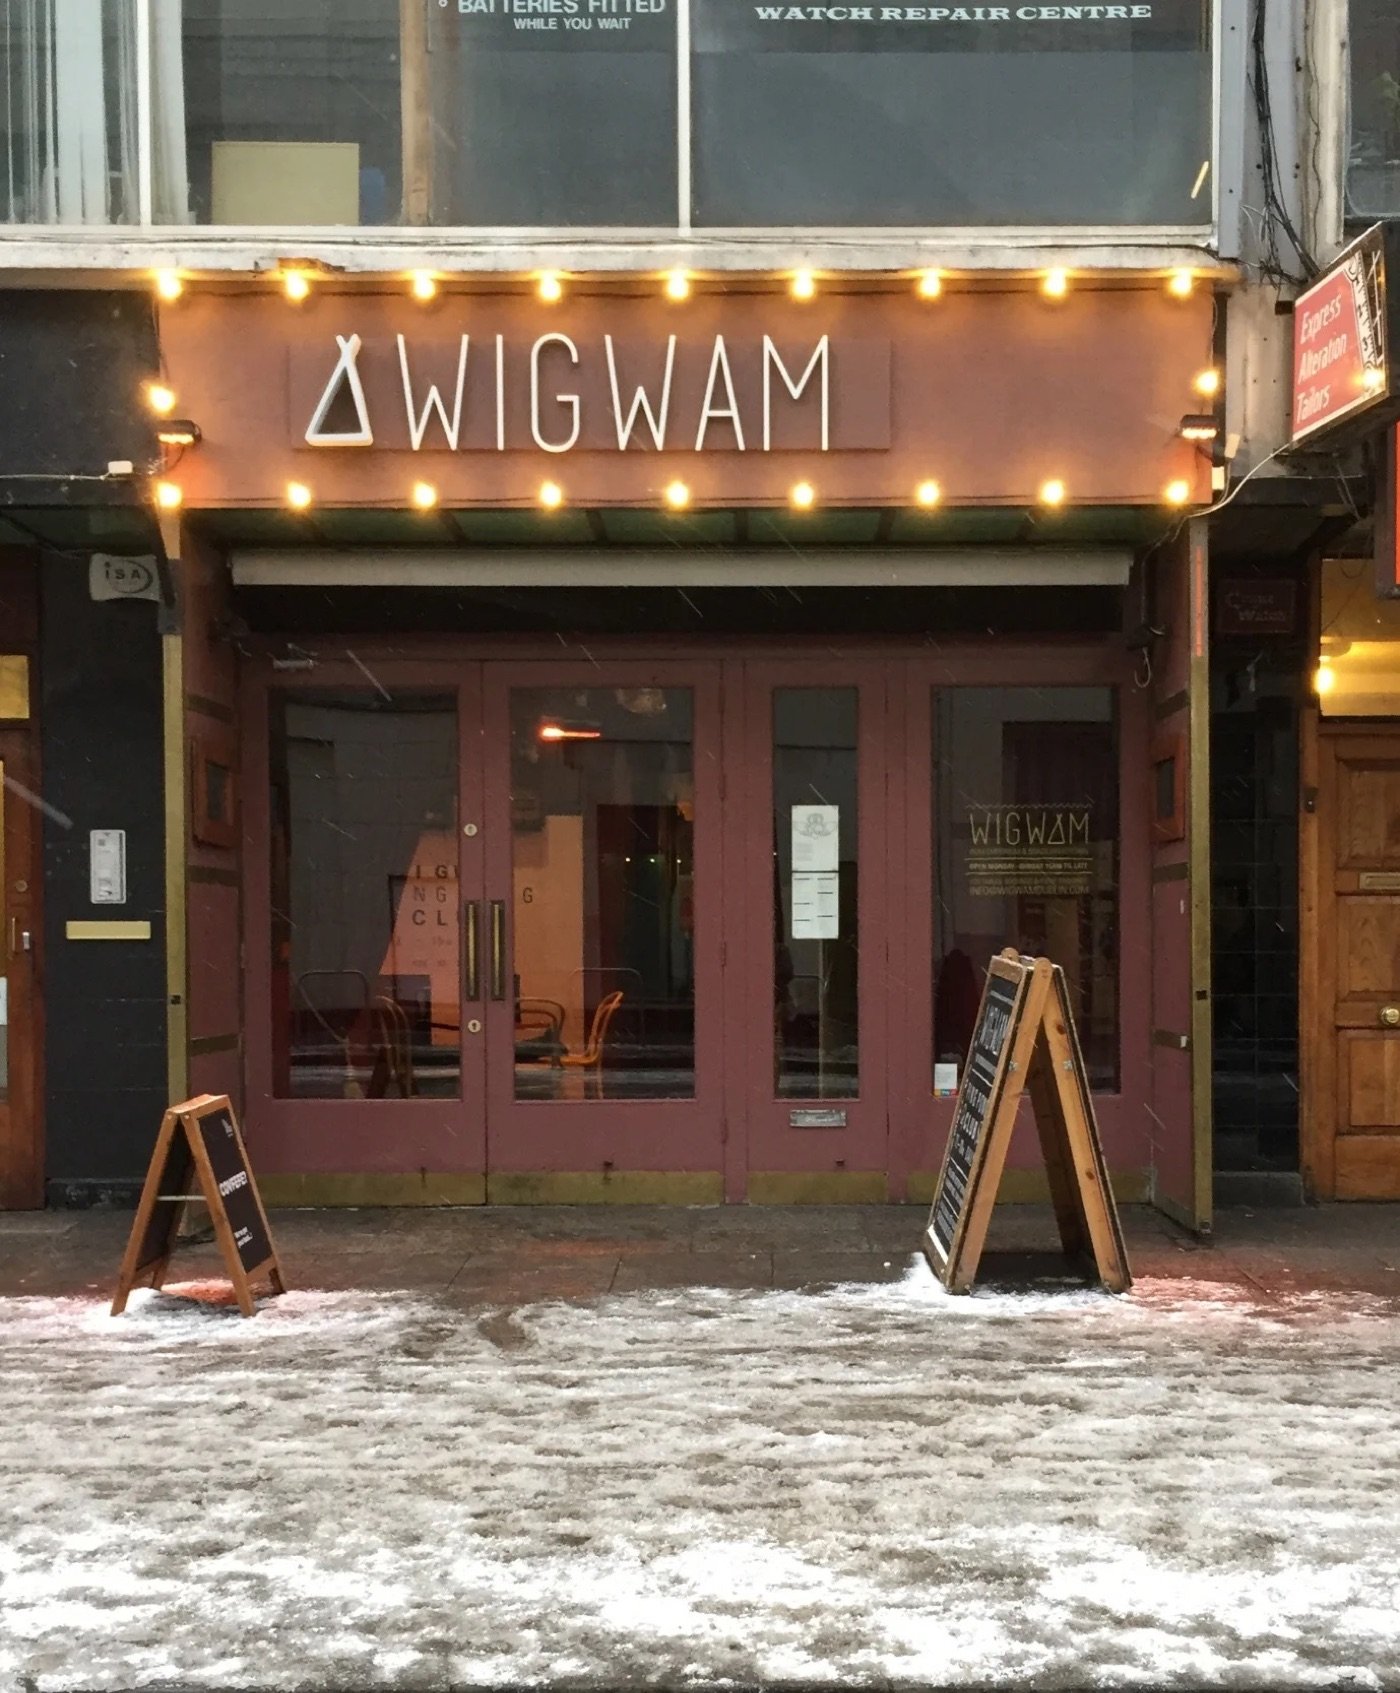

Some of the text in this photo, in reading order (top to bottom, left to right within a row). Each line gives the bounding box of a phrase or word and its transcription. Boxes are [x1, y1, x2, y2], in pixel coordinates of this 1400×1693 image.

[458, 0, 666, 13] BATTERIES FITTED
[513, 17, 631, 29] WHILE YOU WAIT
[754, 5, 1152, 20] WATCH REPAIR CENTRE
[1300, 293, 1342, 345] Express
[1297, 332, 1347, 386] Alteration
[396, 332, 829, 452] WIGWAM
[1296, 383, 1331, 424] Tailors
[969, 811, 1090, 846] WIGWAM
